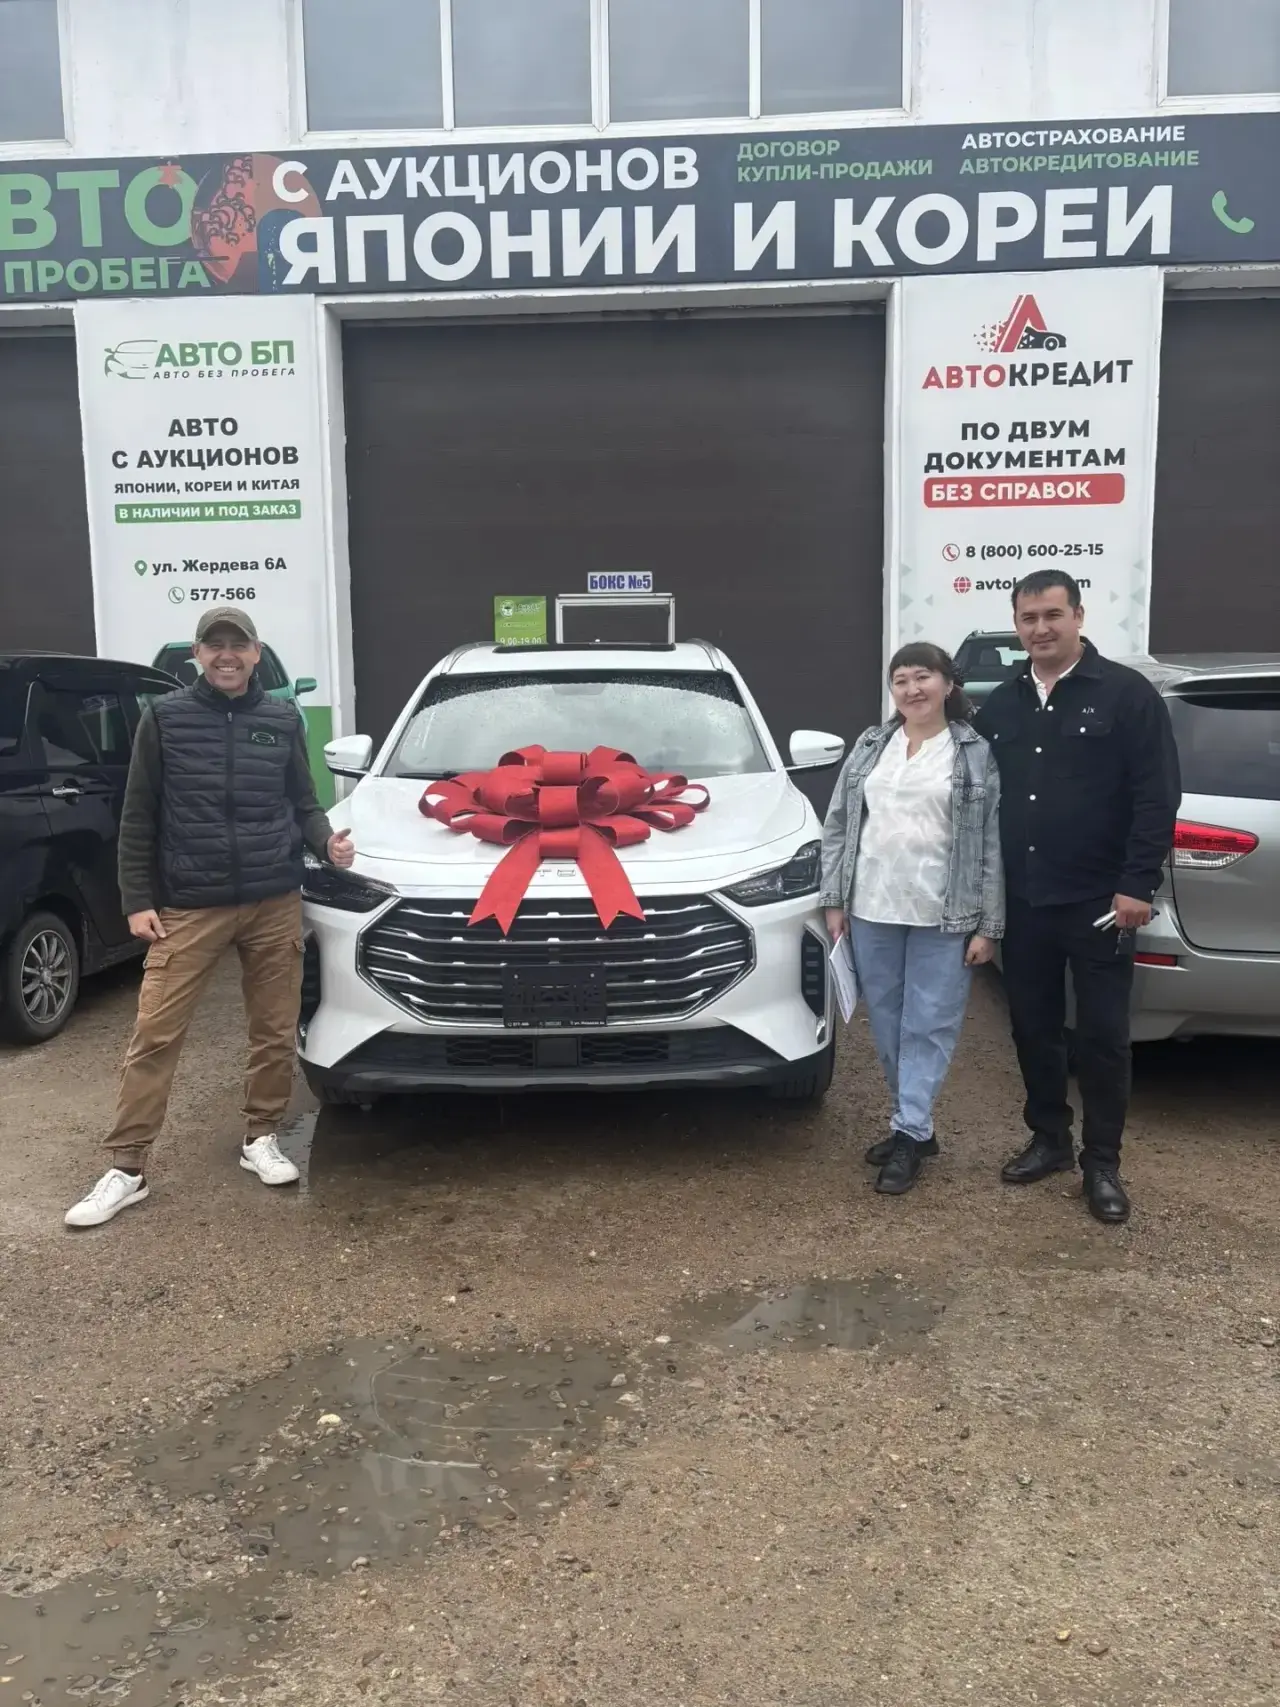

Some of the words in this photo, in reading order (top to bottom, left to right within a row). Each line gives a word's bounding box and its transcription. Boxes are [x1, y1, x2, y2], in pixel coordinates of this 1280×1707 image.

[962, 125, 1186, 150] АВТОСТРАХОВАНИЕ
[737, 139, 840, 162] ДОГОВОР
[959, 149, 1200, 175] АВТОКРЕДИТОВАНИЕ
[272, 160, 309, 203] С
[325, 147, 699, 204] АУКЦИОНОВ
[737, 159, 933, 183] КУПЛИ-ПРОДАЖИ
[279, 204, 696, 285] ЯПОНИИ
[733, 200, 796, 271] И
[833, 185, 1173, 268] КОРЕИ
[4, 256, 211, 294] ПРОБЕГА
[155, 340, 242, 367] АВТО
[251, 340, 294, 365] БП
[153, 371, 190, 380] АВТО
[198, 370, 223, 379] БЕЗ
[231, 367, 295, 378] ПРОБЕГА
[922, 360, 1134, 389] АВТОКРЕДИТ
[168, 417, 239, 437] АВТО
[961, 421, 1000, 441] ПО
[1008, 419, 1090, 443] ДВУМ
[111, 451, 129, 469] С
[137, 446, 299, 470] АУКЦИОНОВ
[924, 448, 1126, 474] ДОКУМЕНТАМ
[114, 482, 181, 495] ЯПОНИИ,
[184, 481, 233, 493] КОРЕИ
[237, 480, 247, 491] И
[252, 478, 300, 491] КИТАЯ
[931, 483, 973, 502] БЕЗ
[980, 480, 1091, 501] СПРАВОК
[119, 509, 129, 519] В
[132, 506, 201, 519] НАЛИЧИИ
[204, 506, 215, 517] И
[218, 505, 250, 518] ПОД
[252, 503, 297, 516] ЗАКАЗ
[965, 545, 976, 558] 8
[980, 544, 1023, 561] (800)
[1027, 543, 1104, 557] 600-25-15
[152, 562, 178, 576] ул.
[182, 559, 260, 574] Жердева
[264, 557, 288, 571] 6А
[190, 587, 256, 602] 577-566
[590, 575, 625, 590] БОКС
[628, 575, 651, 589] №5
